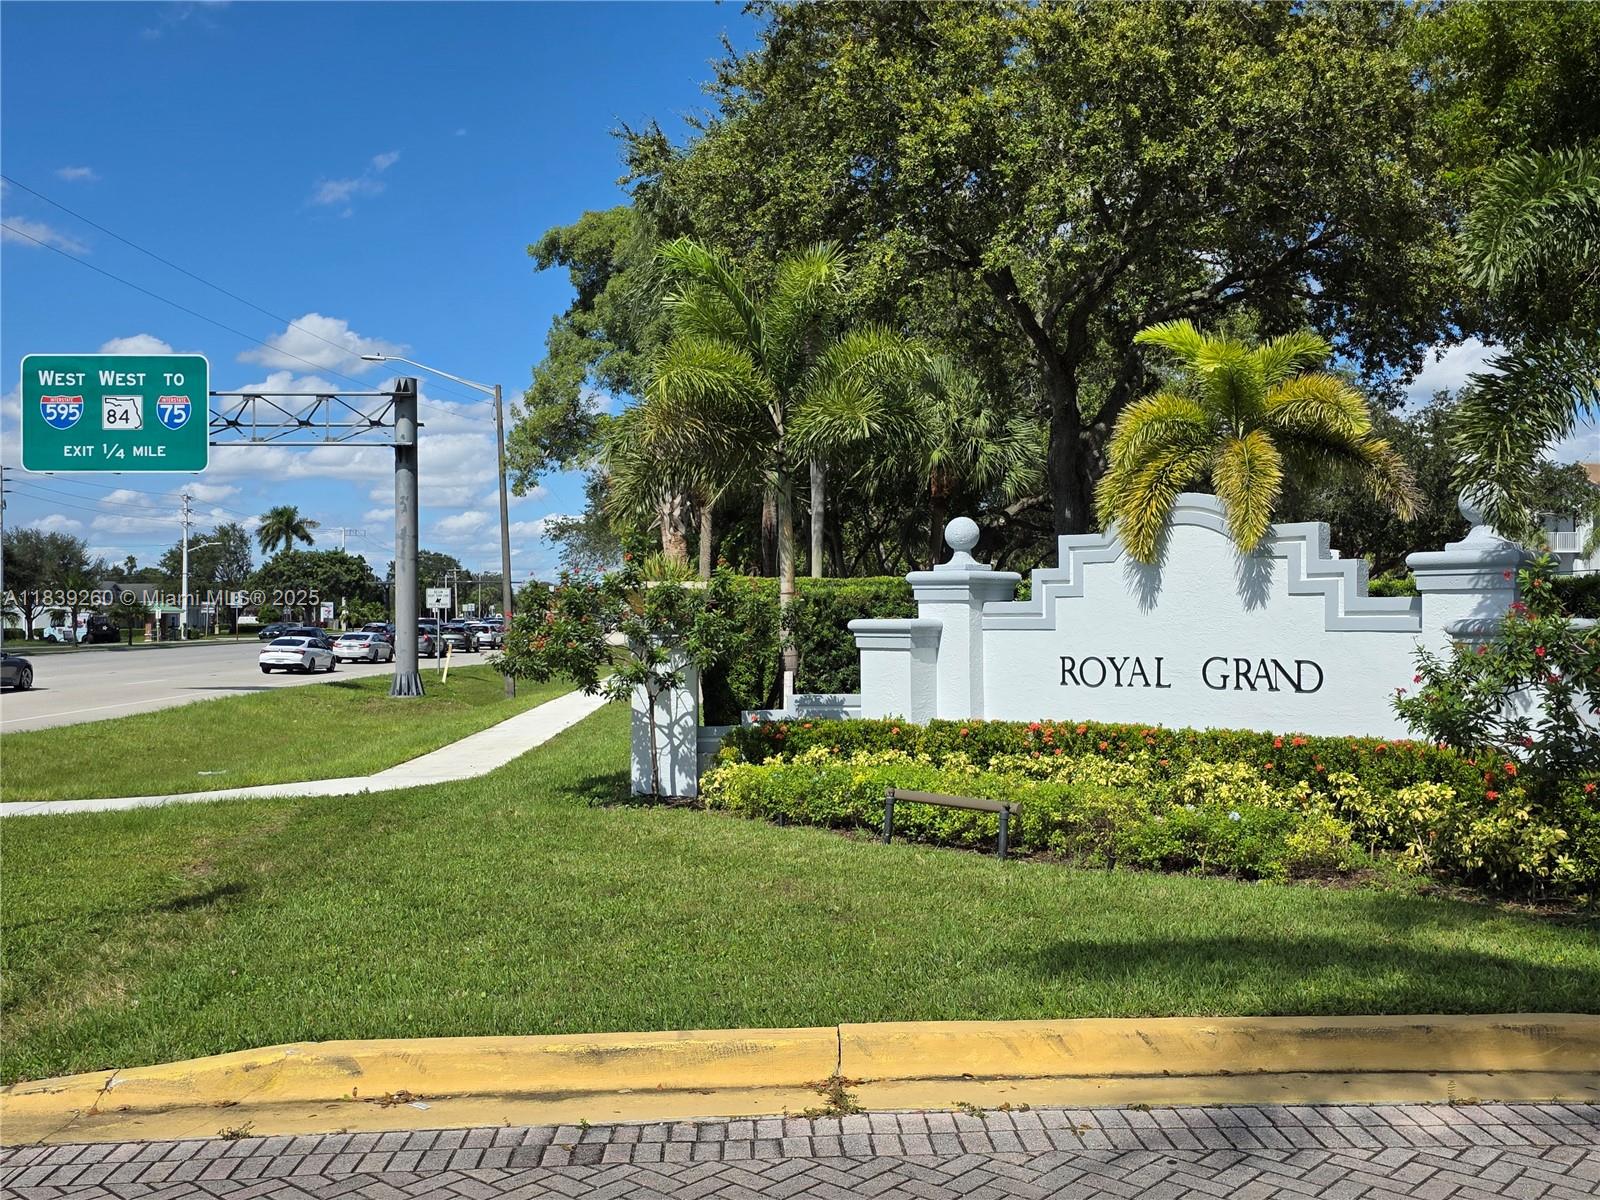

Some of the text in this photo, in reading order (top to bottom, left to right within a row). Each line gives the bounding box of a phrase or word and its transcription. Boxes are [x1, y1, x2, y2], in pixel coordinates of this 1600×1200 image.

[38, 370, 185, 386] WEST WEST TO
[46, 404, 80, 421] 595
[106, 409, 130, 424] 84
[160, 404, 187, 423] 75
[63, 445, 95, 457] EXIT
[132, 445, 167, 457] MILE
[1059, 656, 1324, 694] ROYAL GRAND
